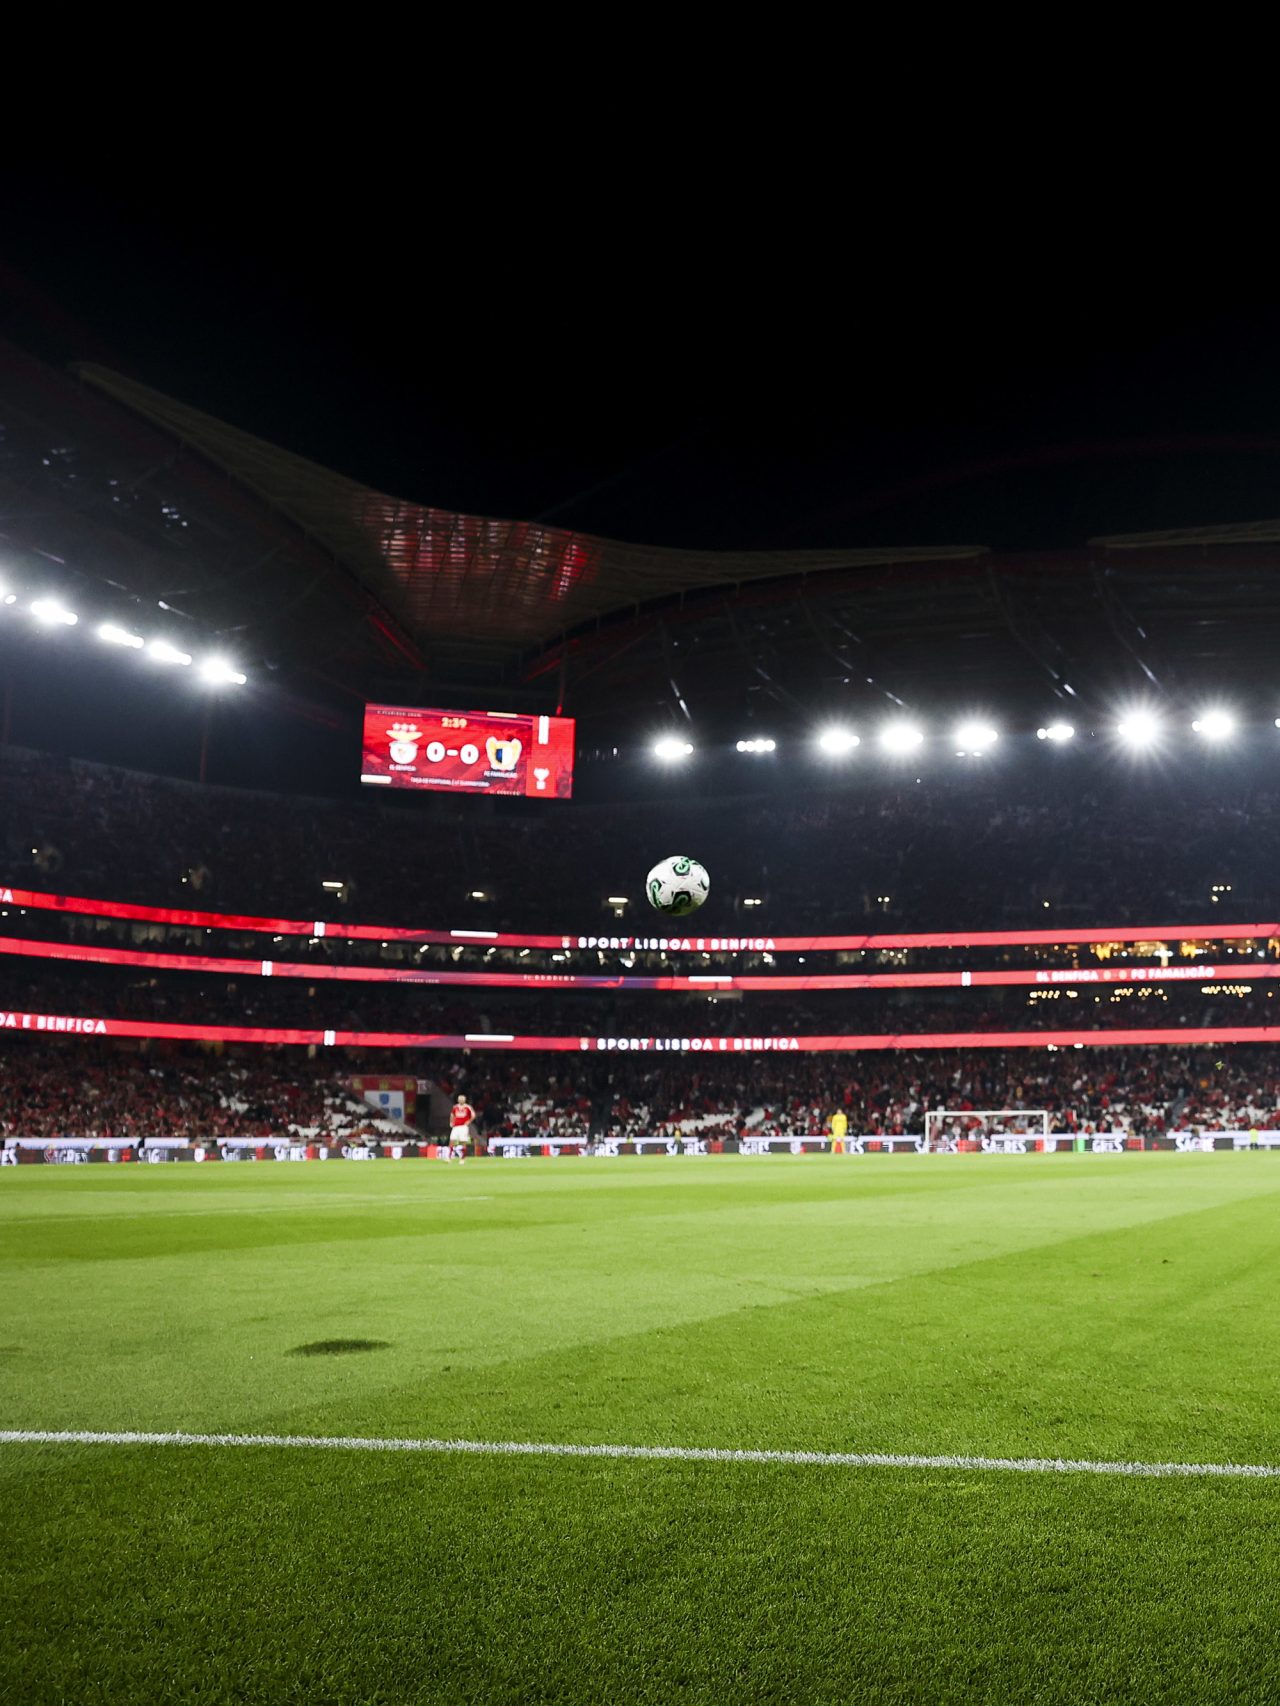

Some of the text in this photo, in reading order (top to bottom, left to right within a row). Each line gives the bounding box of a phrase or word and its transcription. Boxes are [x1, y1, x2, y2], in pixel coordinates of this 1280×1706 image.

[578, 936, 776, 950] SPORT LISBOA E BENFICA
[1051, 970, 1099, 982] BENFICA
[22, 1014, 32, 1029] E
[37, 1015, 107, 1034] BENFICA
[597, 1038, 800, 1050] SPORT LISBOA E BENFICA
